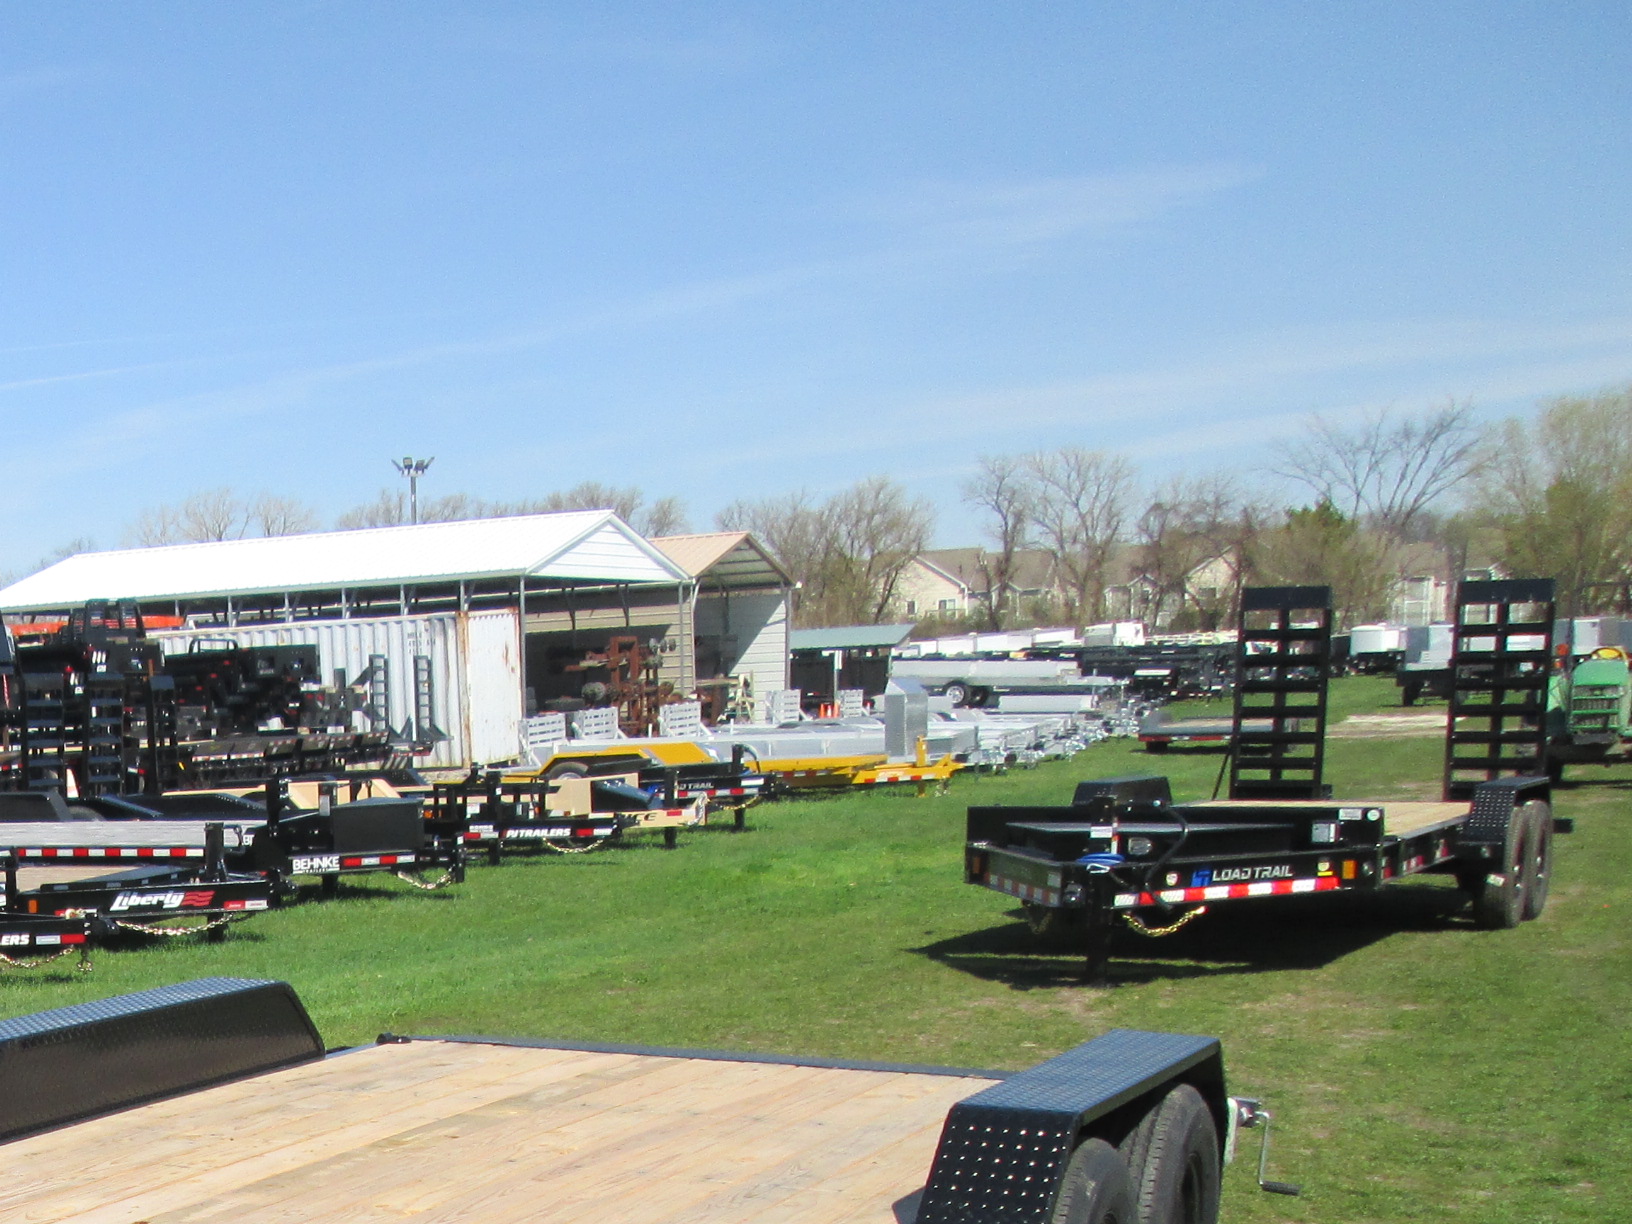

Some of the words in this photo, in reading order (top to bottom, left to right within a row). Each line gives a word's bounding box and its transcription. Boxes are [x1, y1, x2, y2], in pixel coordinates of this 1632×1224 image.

[688, 781, 715, 789] TRAIL
[519, 827, 572, 838] TRAILERS
[292, 856, 340, 871] BEHNKE
[1212, 867, 1250, 882] LOAD
[1253, 865, 1294, 880] TRAIL
[109, 890, 186, 911] Liberty
